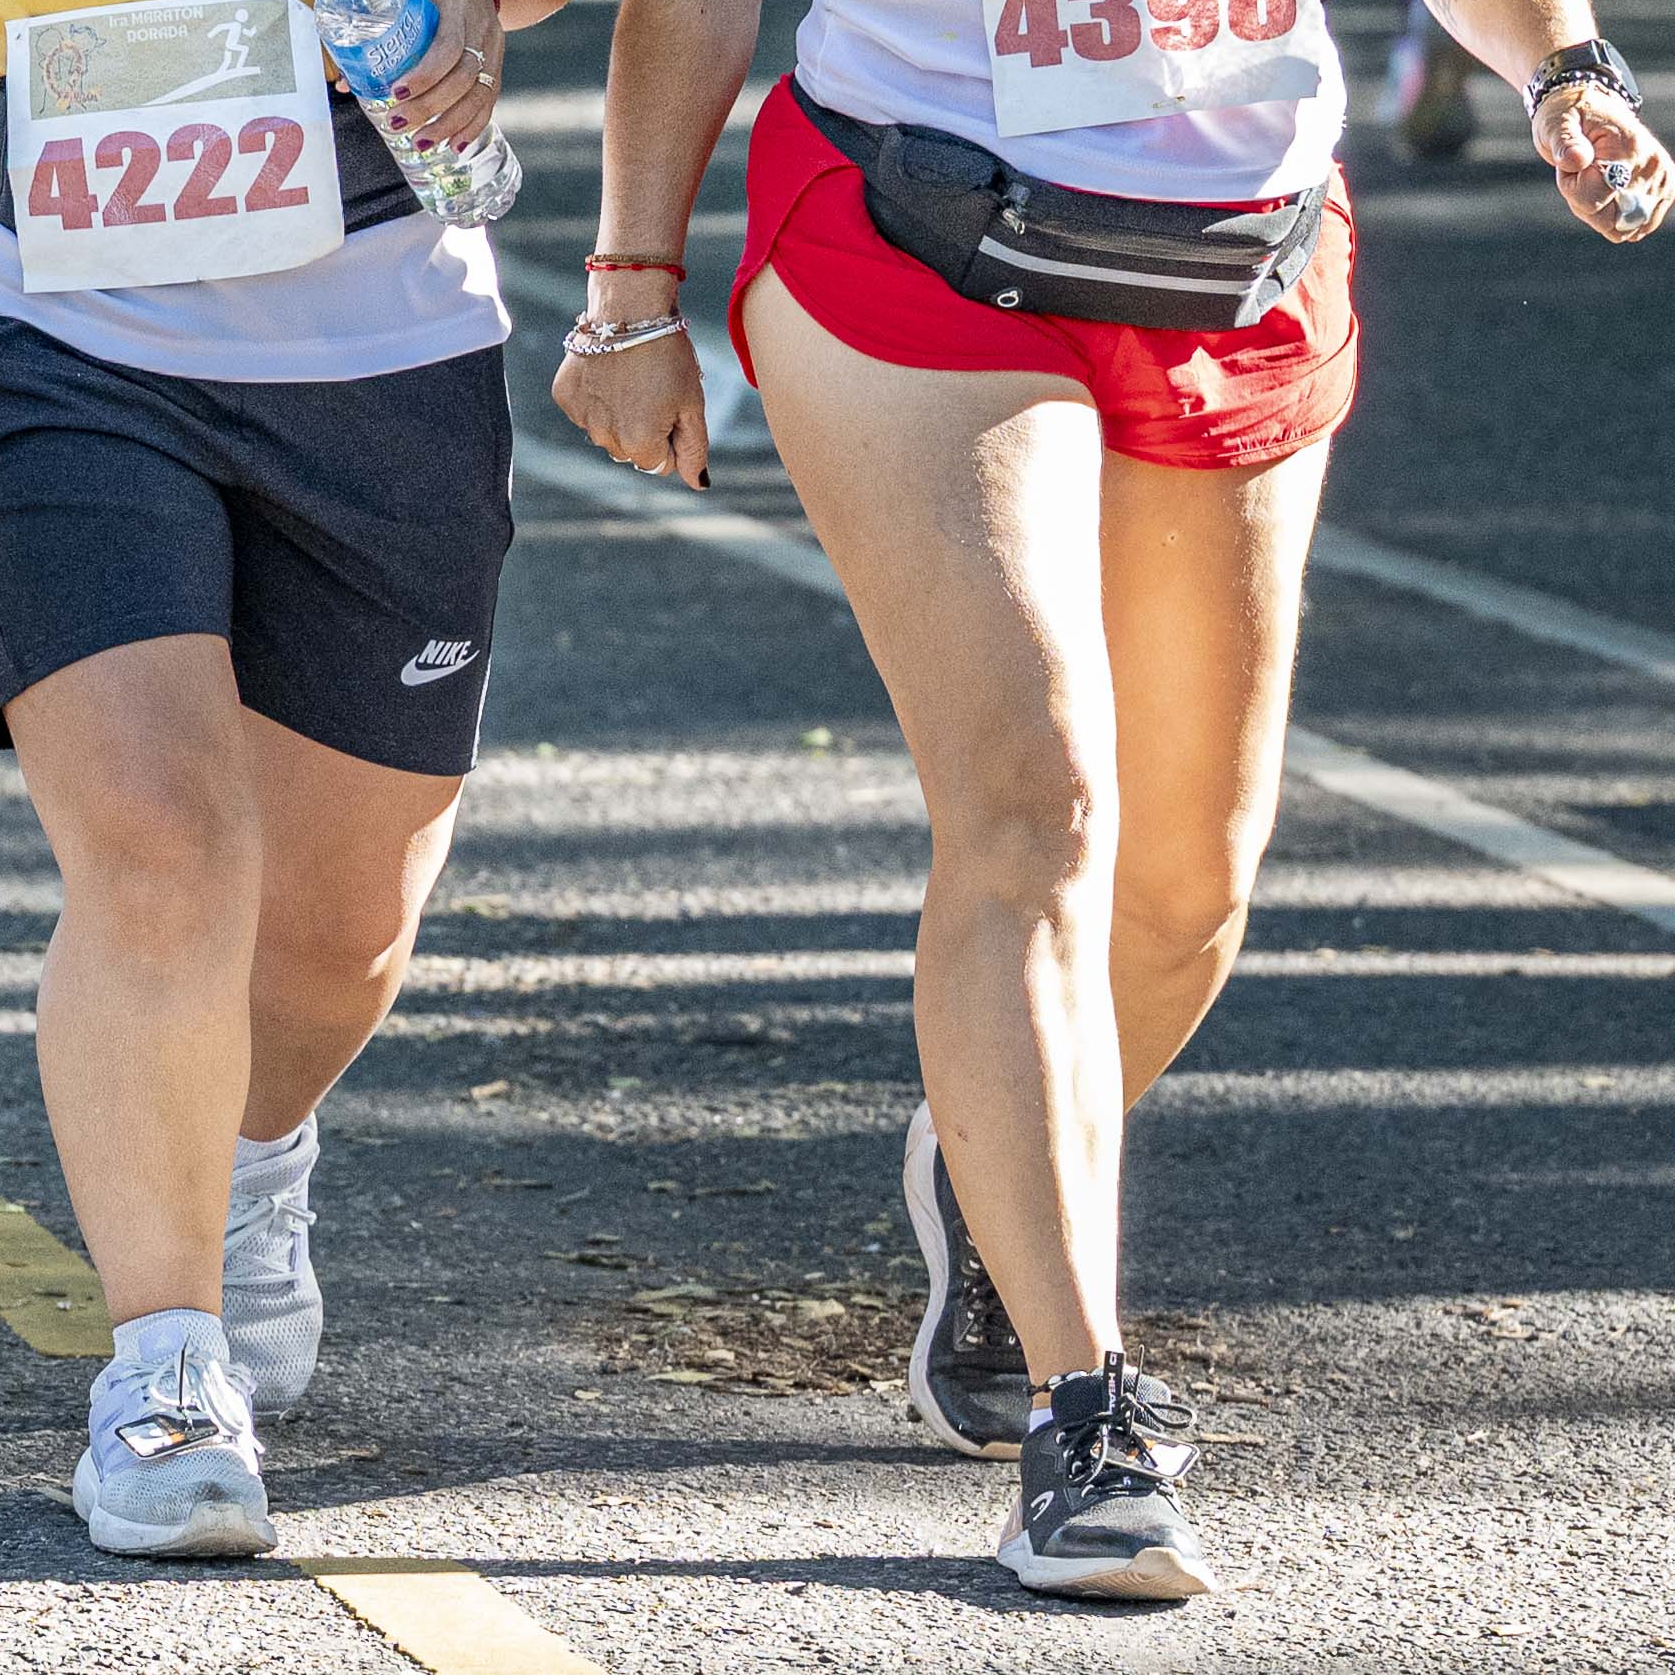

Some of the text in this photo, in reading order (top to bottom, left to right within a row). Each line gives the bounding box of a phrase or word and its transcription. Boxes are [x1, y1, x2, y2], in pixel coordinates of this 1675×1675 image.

[127, 24, 189, 43] DORADA
[367, 10, 415, 66] Sierra
[28, 116, 311, 231] 4222
[417, 639, 472, 666] NIKE
